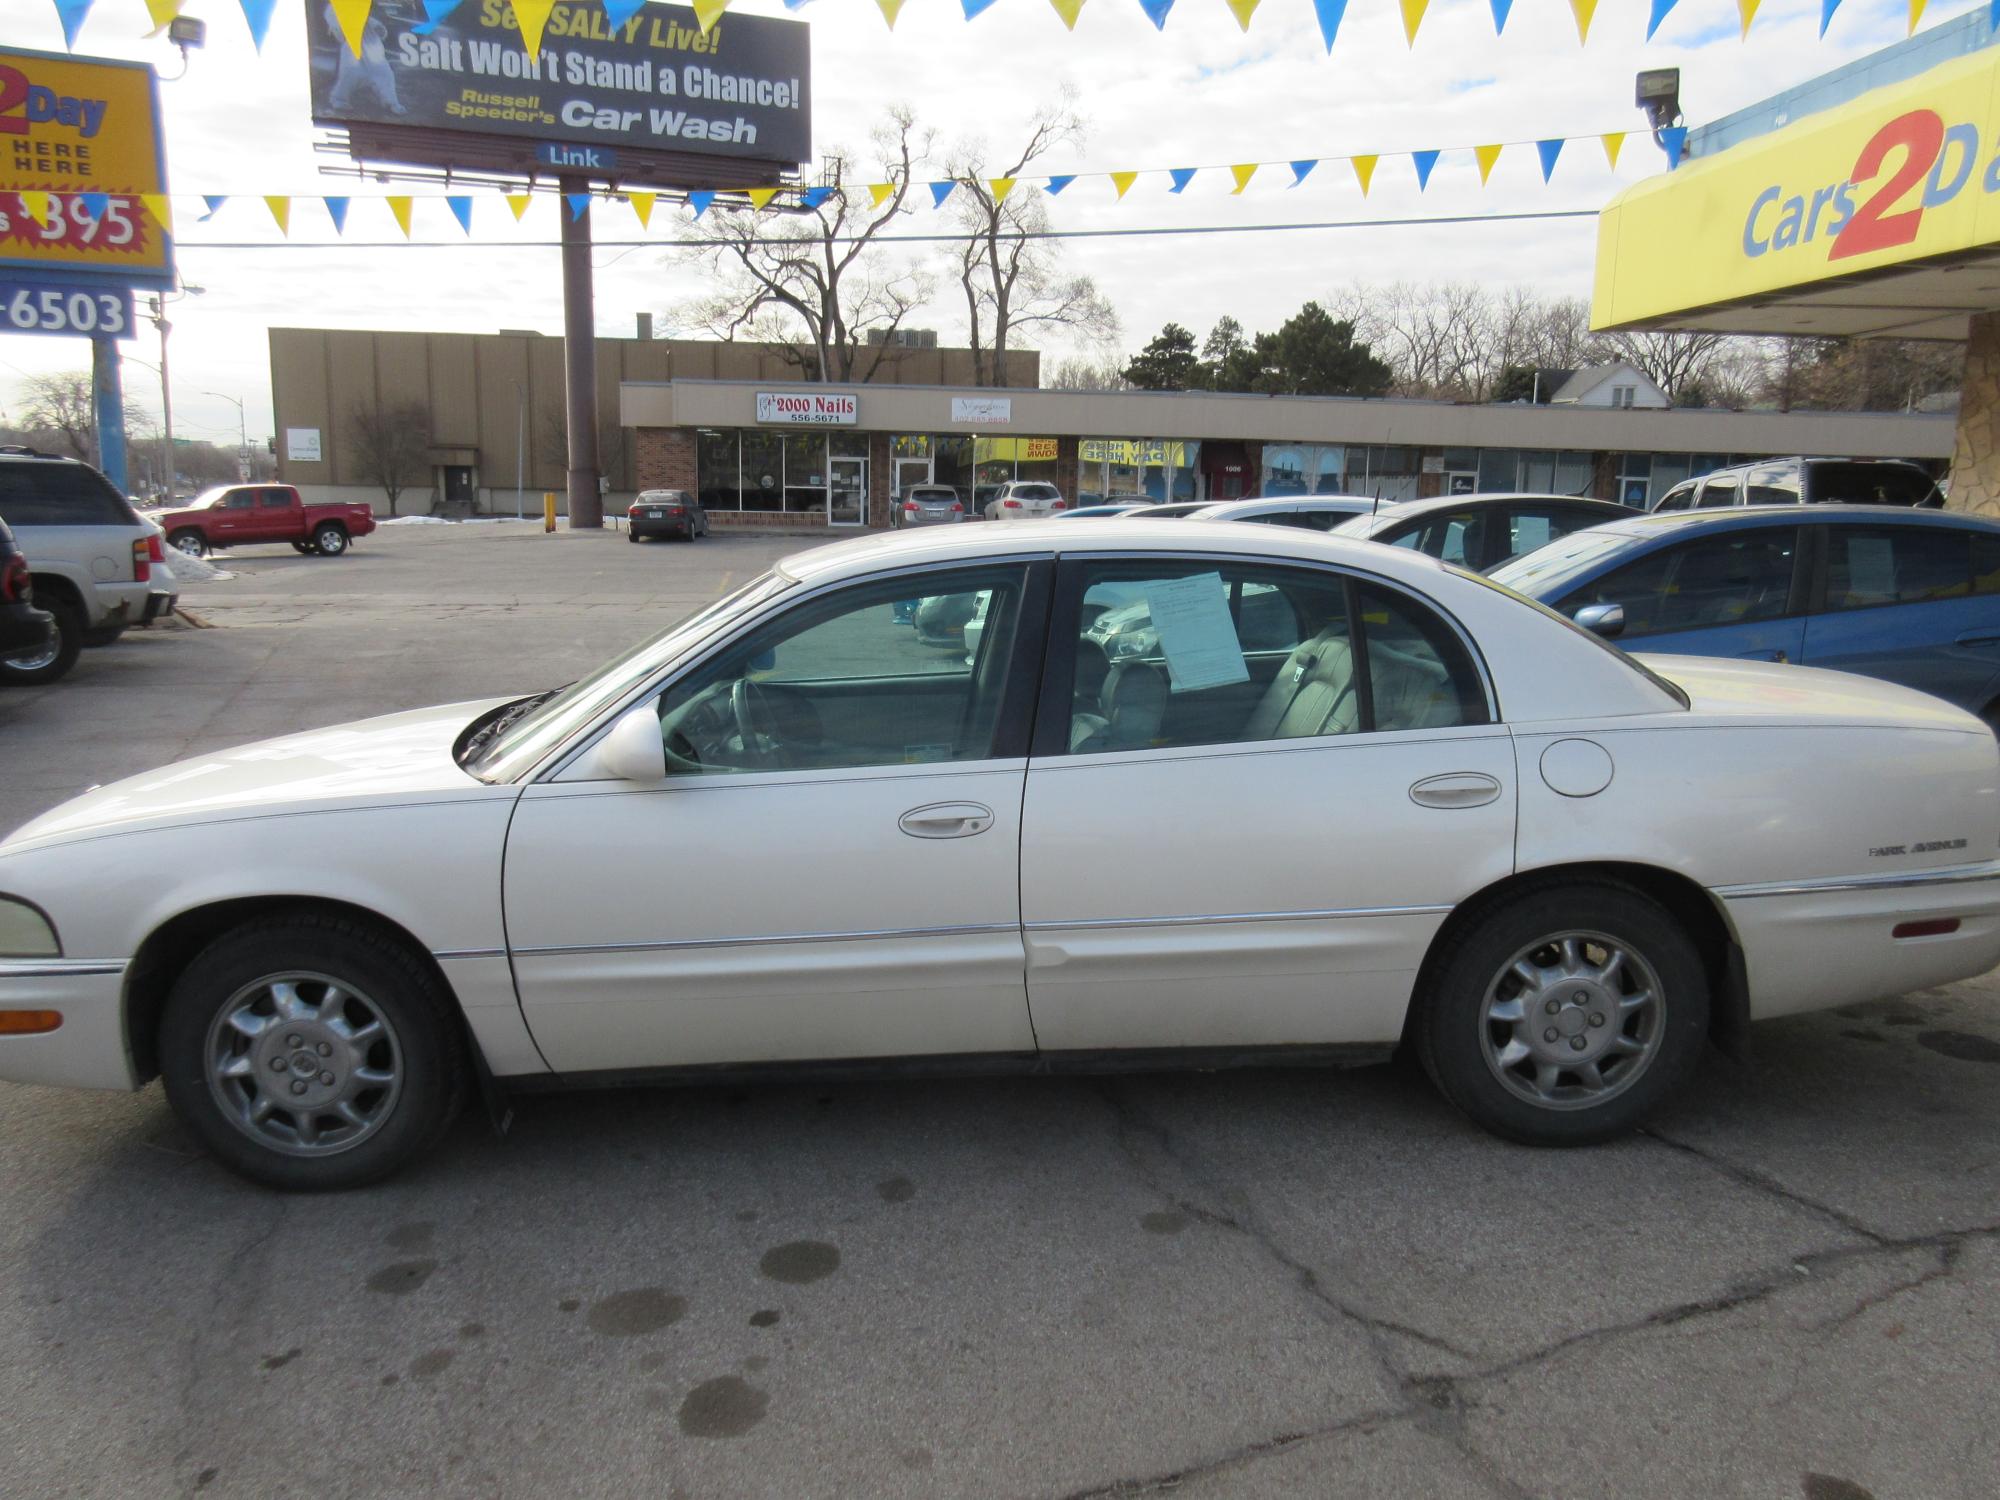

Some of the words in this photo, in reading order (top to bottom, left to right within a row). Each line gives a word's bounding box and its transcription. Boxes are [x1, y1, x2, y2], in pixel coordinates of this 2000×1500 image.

[479, 1, 517, 30] Se
[649, 19, 721, 54] Live!
[399, 33, 464, 72] Salt
[469, 39, 560, 83] Won't
[566, 52, 652, 93] Stand
[659, 66, 677, 96] a
[683, 65, 799, 109] Chance!
[462, 88, 540, 109] Russell
[446, 101, 556, 124] Speeder's
[561, 100, 642, 131] Car
[650, 108, 757, 144] Wash
[13, 140, 90, 159] HERE
[550, 147, 600, 168] Link
[15, 157, 92, 176] HERE
[776, 398, 810, 412] 2000
[815, 397, 854, 413] Nails
[791, 414, 840, 422] 556-5671
